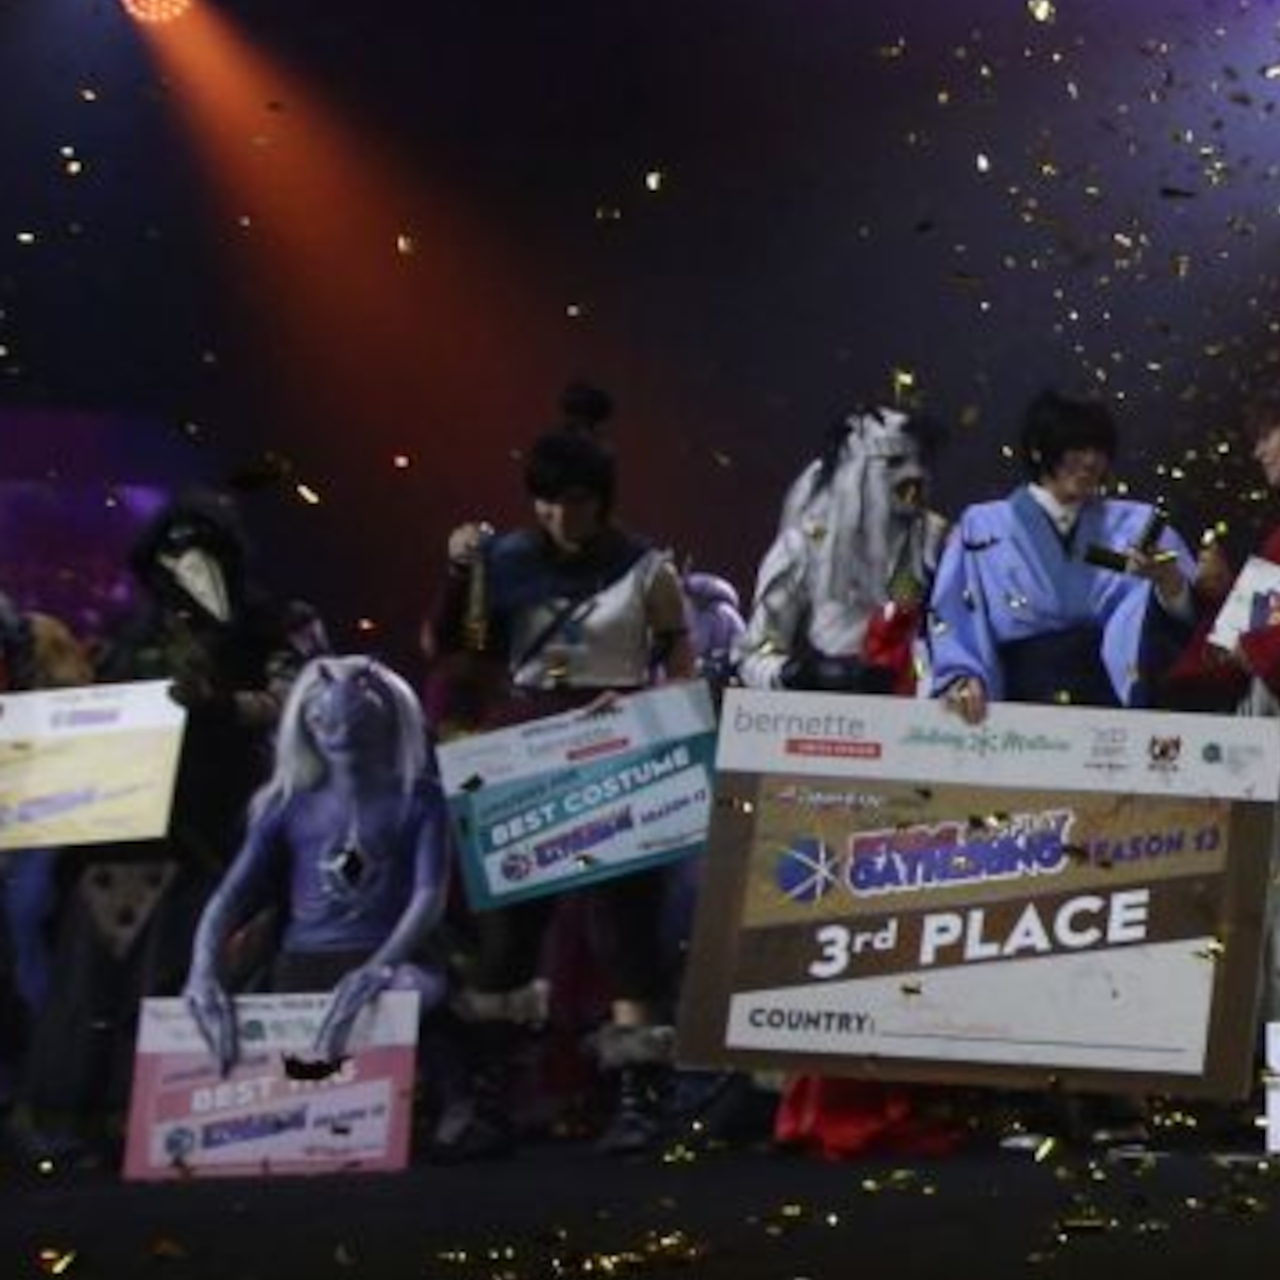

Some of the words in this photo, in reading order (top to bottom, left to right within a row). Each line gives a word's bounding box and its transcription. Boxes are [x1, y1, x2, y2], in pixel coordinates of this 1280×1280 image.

[733, 704, 866, 738] bernette
[491, 800, 557, 846] BEST
[563, 745, 690, 813] COSTUME
[808, 917, 899, 979] 3rd
[919, 888, 1150, 966] PLACE
[748, 1007, 875, 1036] COUNTRY:
[190, 1076, 278, 1113] BEST
